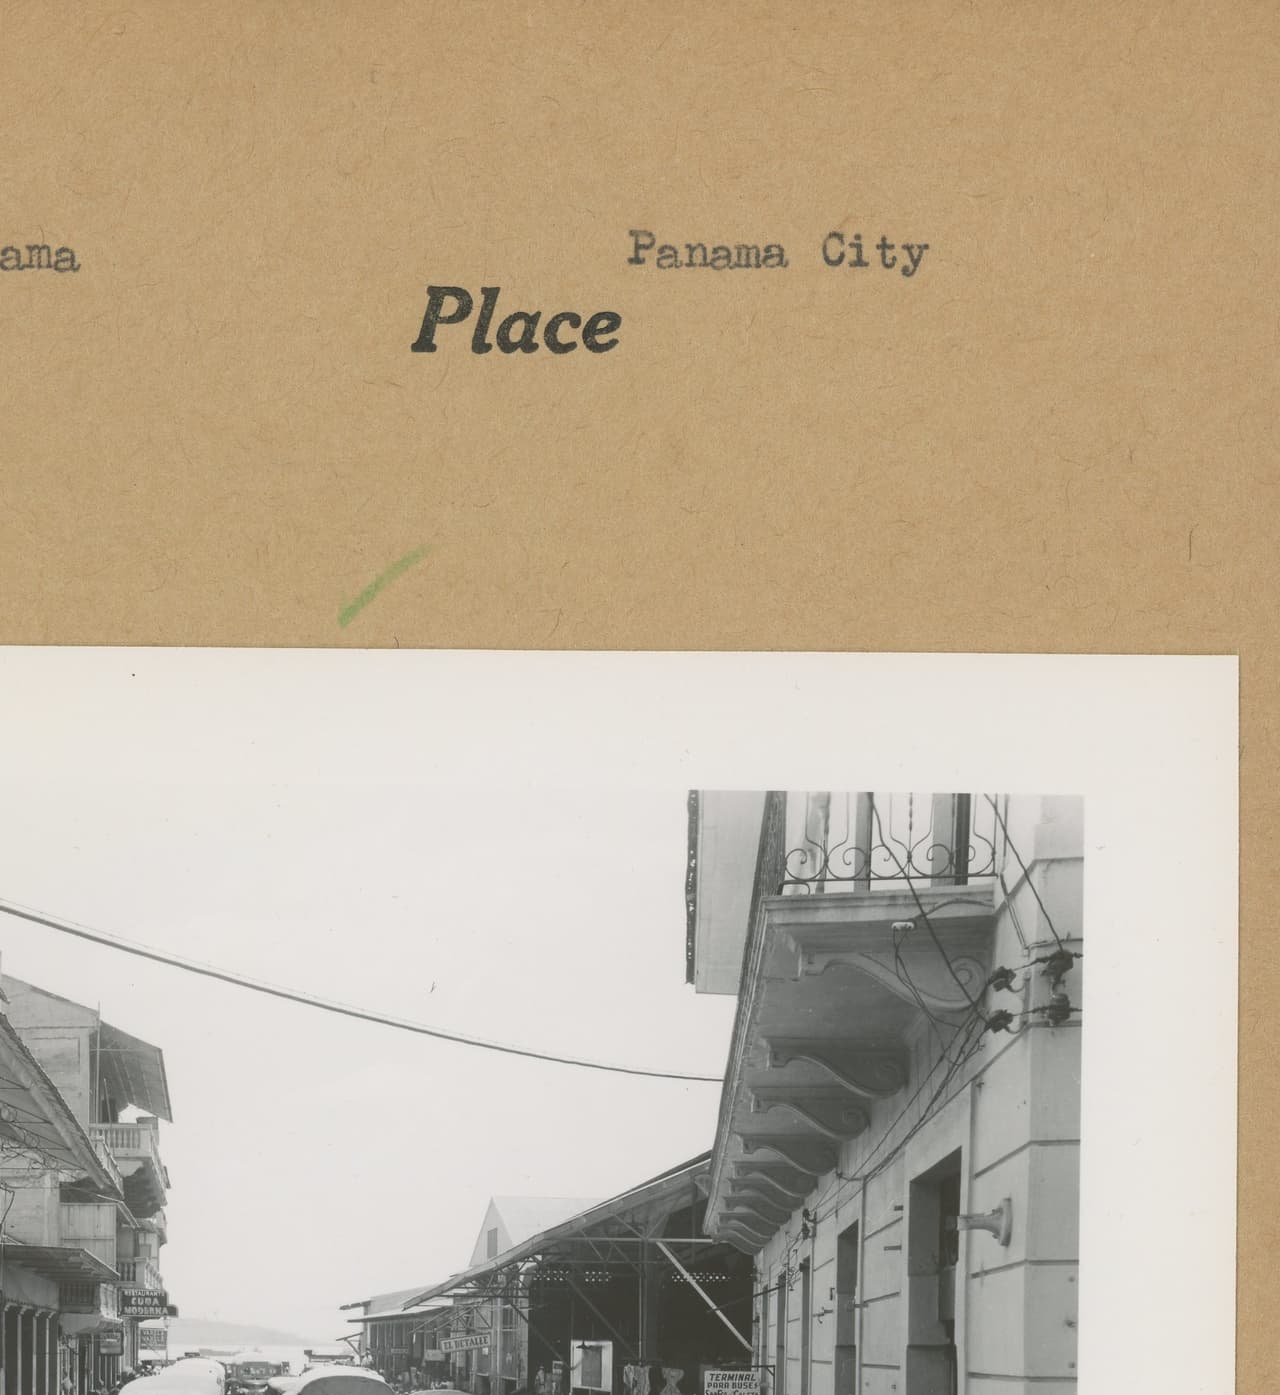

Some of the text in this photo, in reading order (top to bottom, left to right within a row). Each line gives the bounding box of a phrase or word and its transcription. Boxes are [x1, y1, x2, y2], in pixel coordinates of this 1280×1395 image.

[627, 229, 930, 278] Panama City
[410, 284, 623, 356] Place
[123, 1306, 169, 1315] MODERNA
[709, 1373, 757, 1382] TERMINAL
